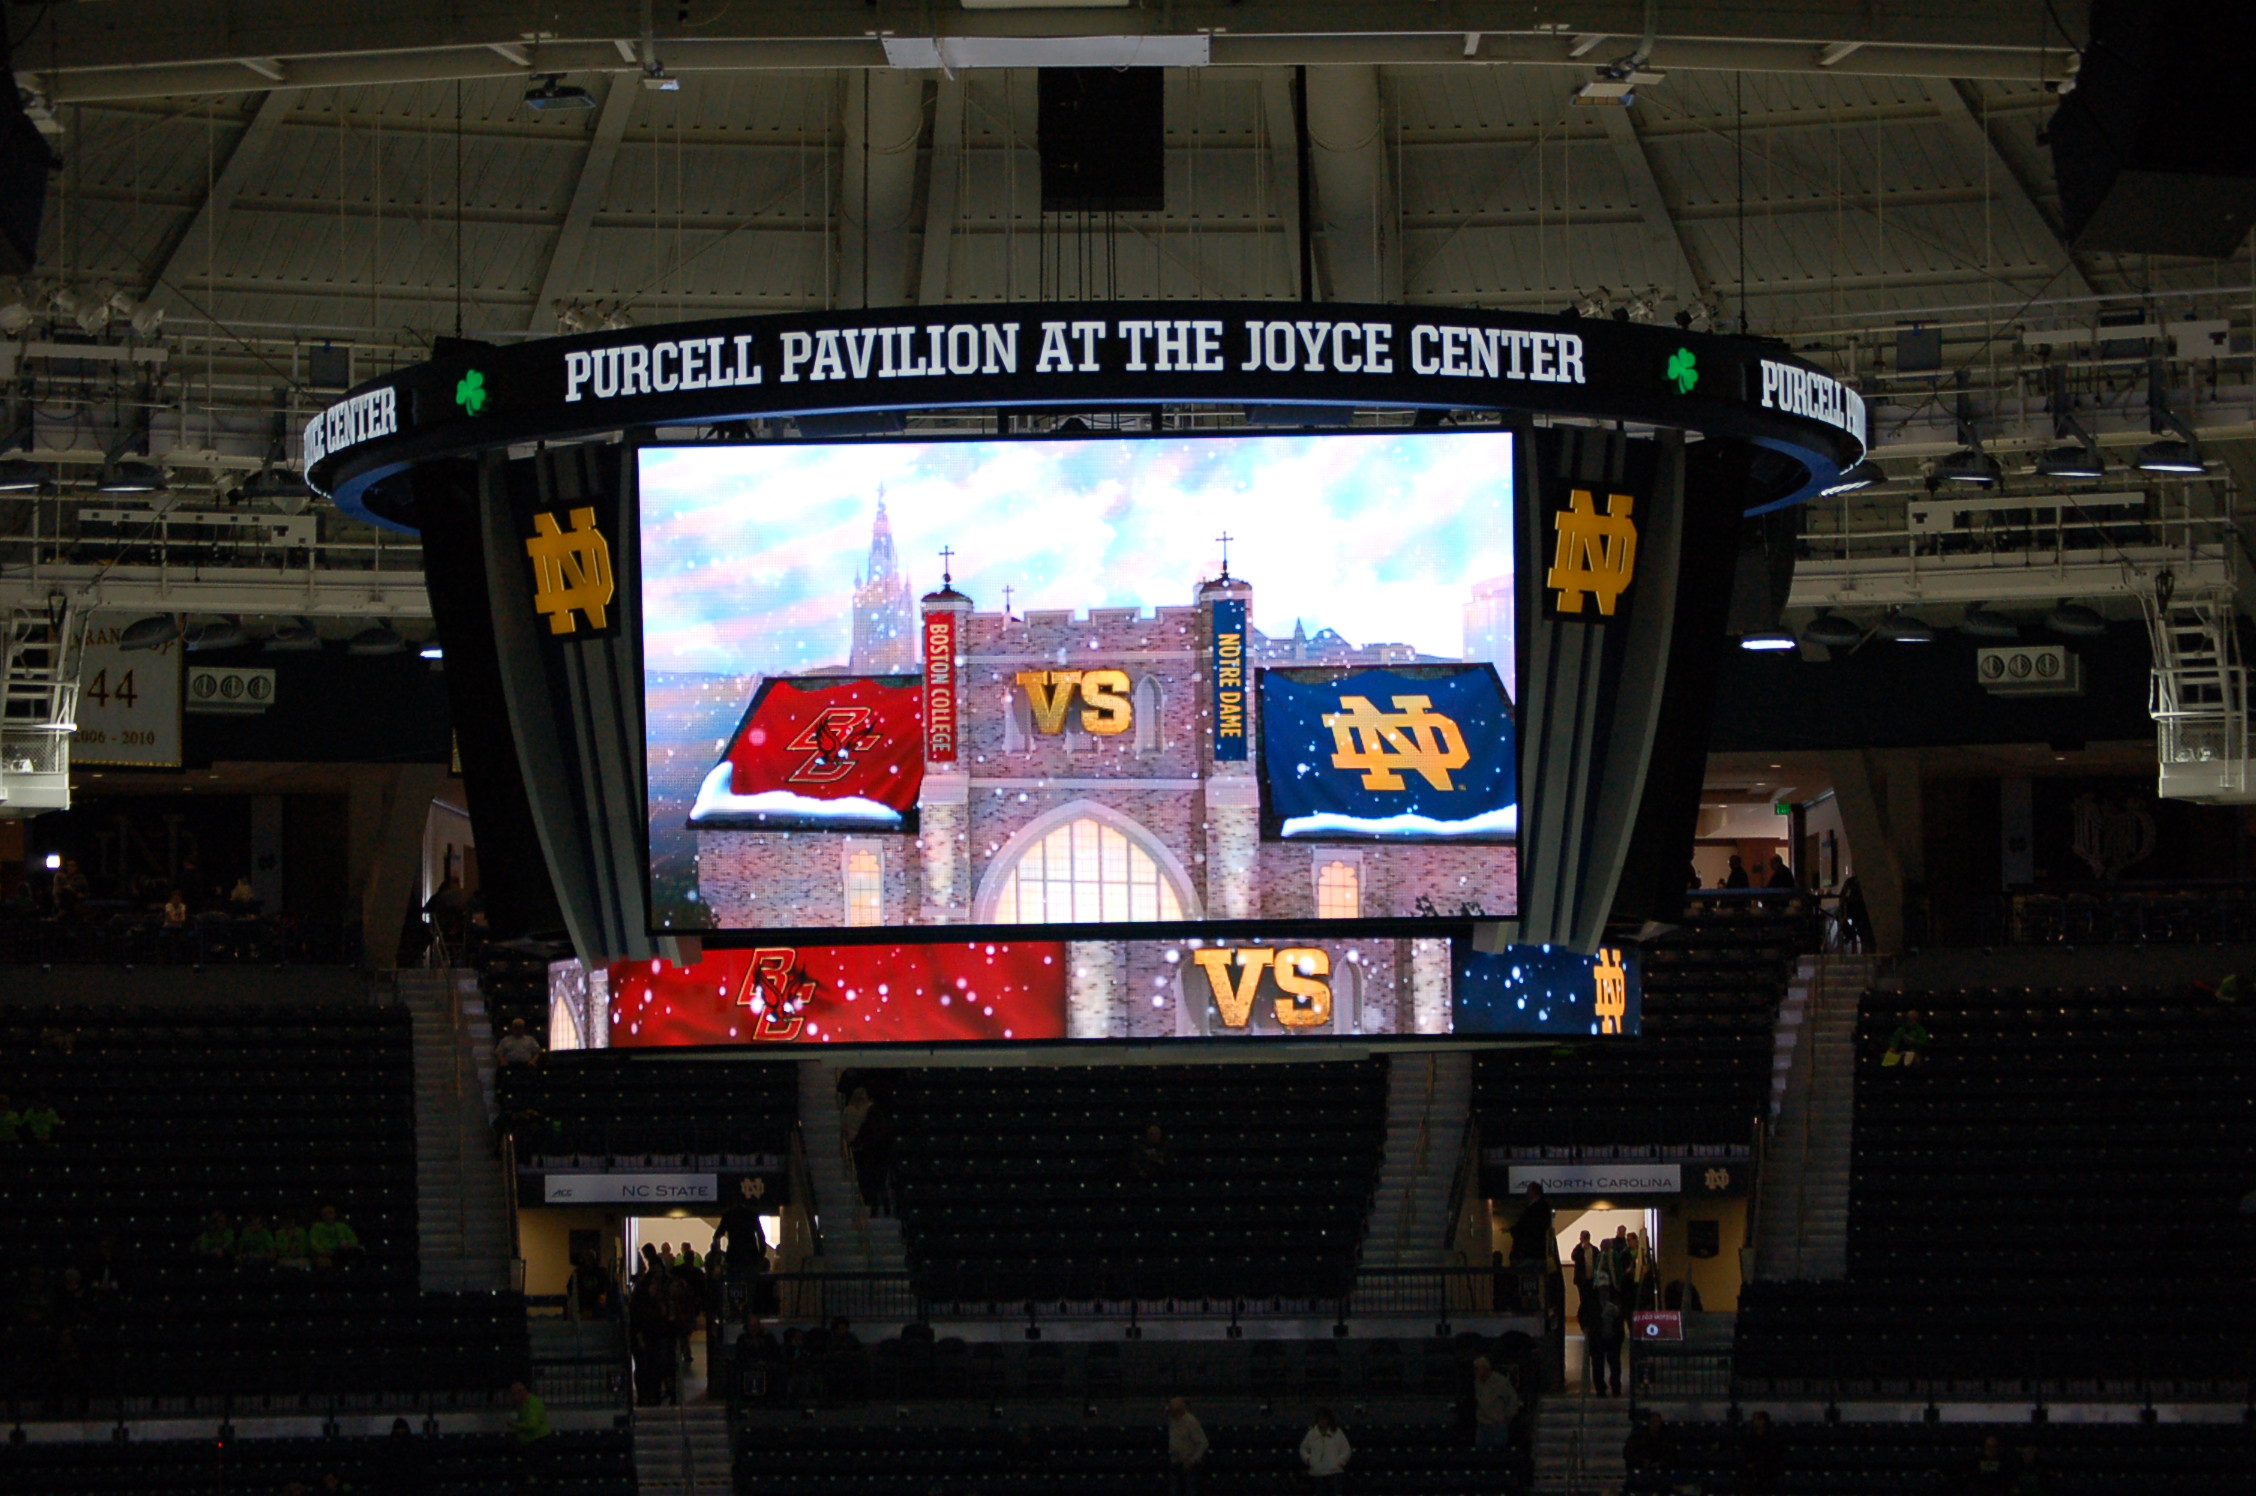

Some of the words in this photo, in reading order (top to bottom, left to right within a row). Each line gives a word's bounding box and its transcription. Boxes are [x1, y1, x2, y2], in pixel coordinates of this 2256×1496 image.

[564, 334, 762, 402] PURCELL
[779, 322, 1020, 383] PAVILION
[1035, 321, 1106, 373] AT
[1118, 320, 1224, 371] THE
[1241, 320, 1393, 374] JOYCE
[1411, 324, 1586, 384] CENTER
[326, 385, 397, 454] CENTER
[1760, 359, 1845, 430] PURCELL
[929, 623, 950, 685] BOSTON
[1218, 633, 1242, 688] NOTRE
[87, 668, 138, 708] 44
[1015, 669, 1132, 734] VS
[1219, 691, 1243, 738] DAME
[121, 730, 155, 746] 2010
[930, 688, 951, 752] COLLEGE
[1193, 947, 1332, 1028] VS
[551, 1188, 573, 1198] ACC
[622, 1184, 650, 1198] NC
[655, 1184, 709, 1198] STATE
[1540, 1177, 1593, 1189] NORTH
[1597, 1177, 1673, 1188] CAROLINA
